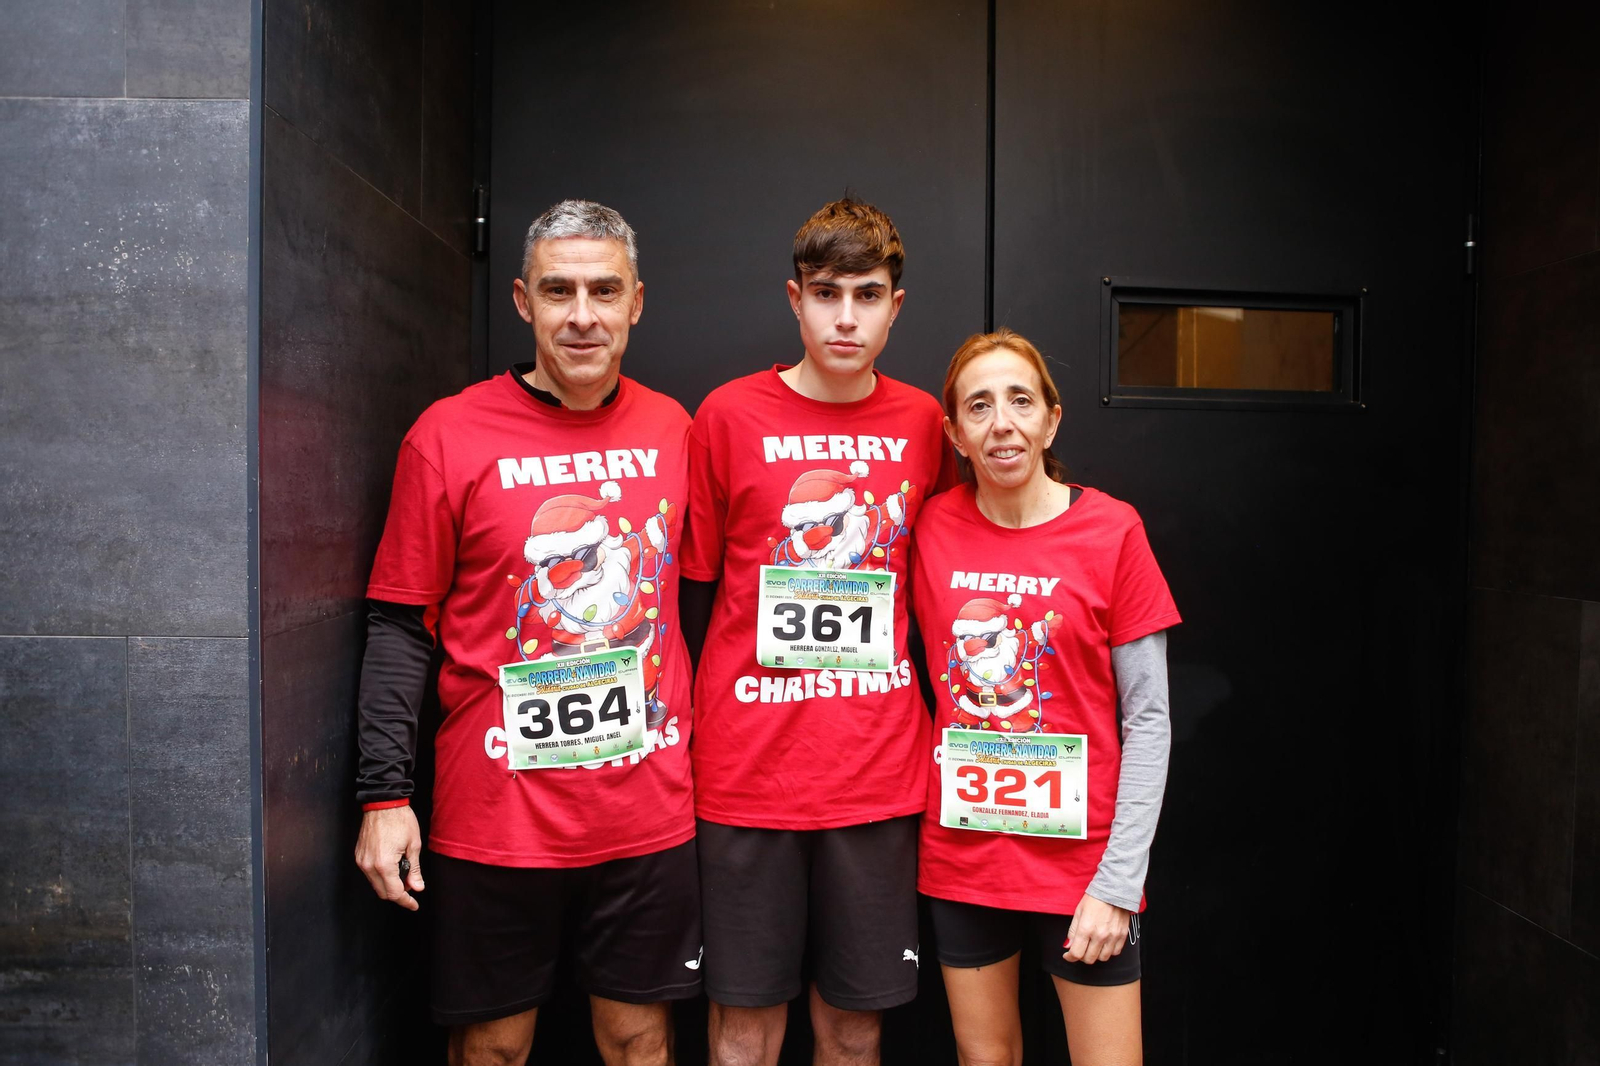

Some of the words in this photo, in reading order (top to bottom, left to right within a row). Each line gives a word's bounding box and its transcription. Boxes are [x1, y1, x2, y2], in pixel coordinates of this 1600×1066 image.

[763, 434, 908, 463] MERRY
[498, 448, 658, 489] MERRY
[788, 578, 830, 594] CARRERA
[831, 580, 869, 595] NAVIDAD
[950, 570, 1060, 596] MERRY
[772, 603, 873, 643] 361
[815, 645, 839, 653] GONZALEZ,
[841, 646, 858, 654] MIGUEL
[528, 667, 574, 689] CARRERA
[574, 661, 617, 682] NAVIDAD
[586, 677, 618, 688] ALGECIRAS
[735, 659, 911, 703] CHRISTMAS
[518, 686, 631, 739] 364
[535, 741, 559, 749] HERRERA
[560, 739, 583, 748] TORRES,
[584, 734, 605, 744] MIGUEL
[607, 732, 621, 741] ANGEL
[970, 741, 1013, 757] CARRERA
[1014, 744, 1057, 760] NAVIDAD
[957, 765, 1061, 808] 321
[972, 806, 997, 815] GONZALEZ
[998, 808, 1029, 818] FERNANDEZ,
[1031, 811, 1049, 819] ELADIA
